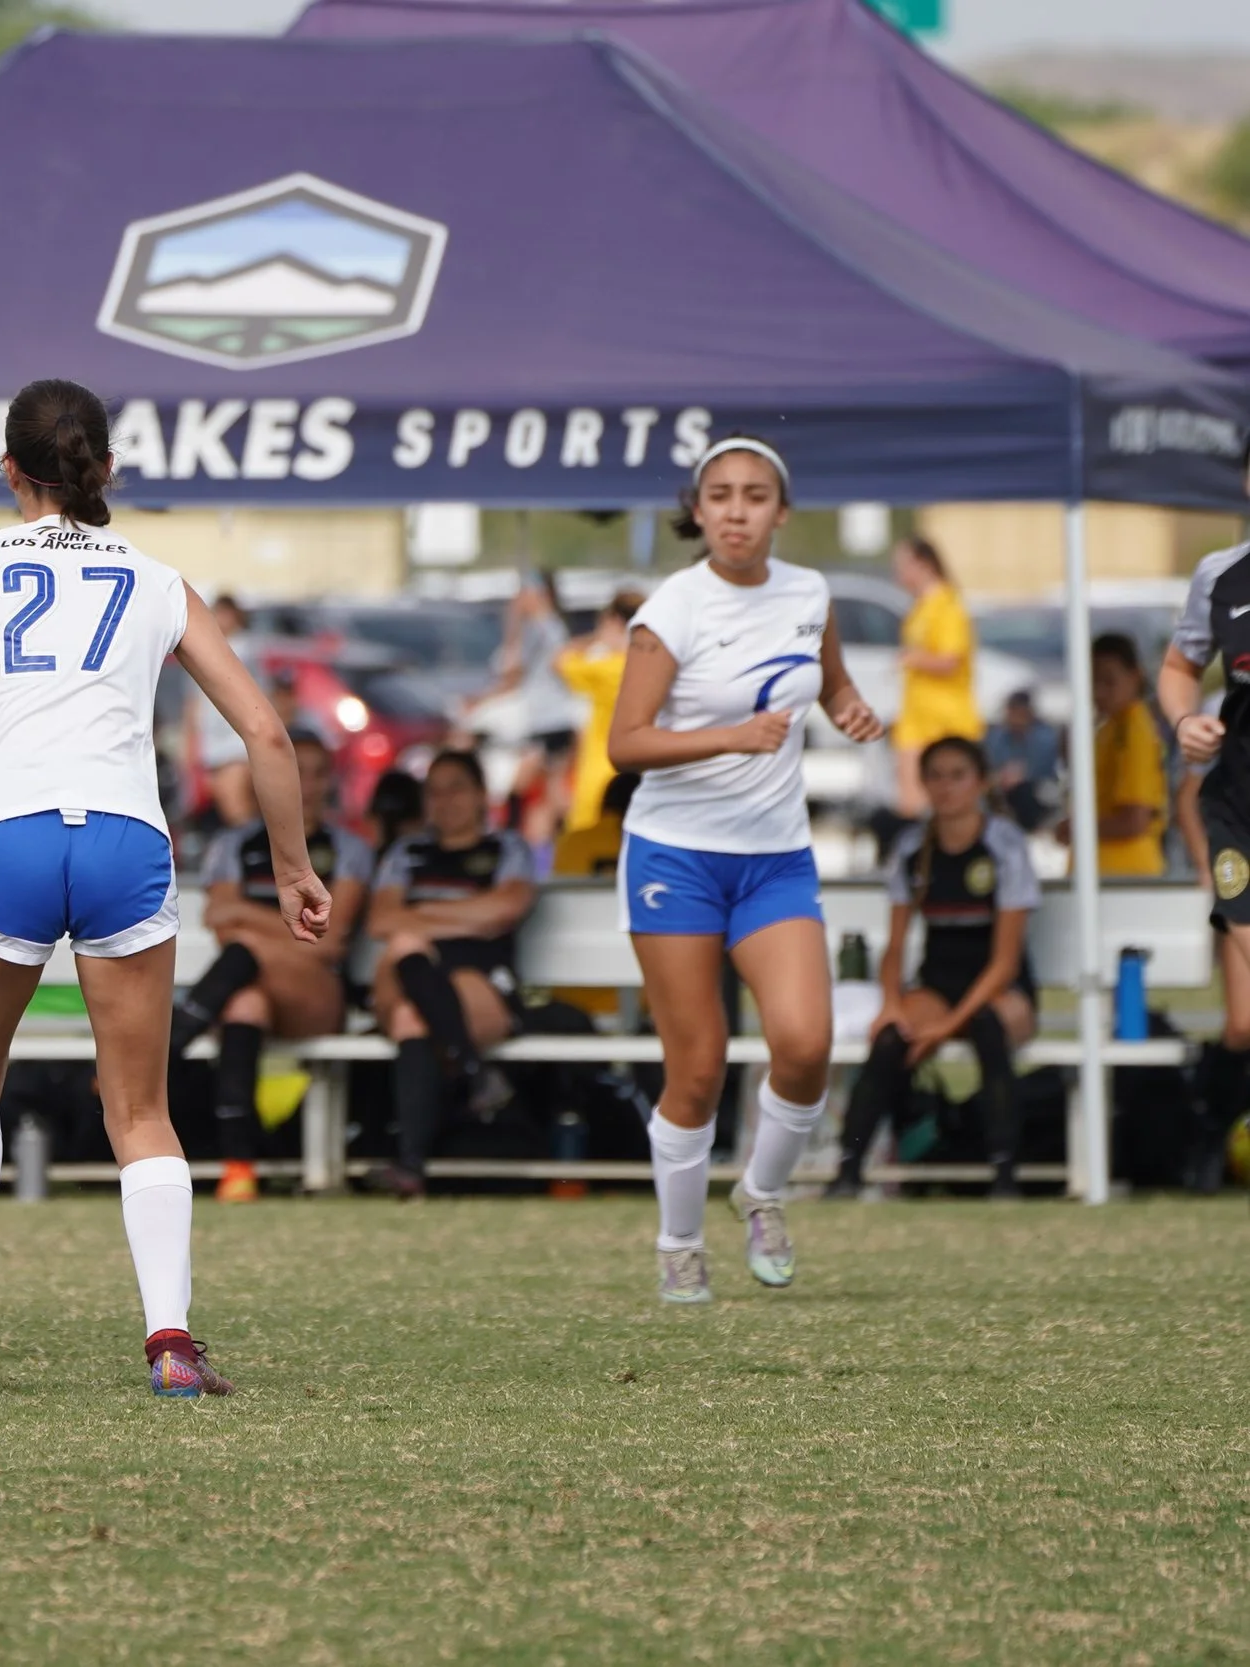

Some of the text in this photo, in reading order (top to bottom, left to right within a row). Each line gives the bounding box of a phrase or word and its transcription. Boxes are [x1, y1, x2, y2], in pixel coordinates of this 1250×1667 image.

[392, 406, 713, 469] SPORTS
[1, 538, 128, 555] LOS ANGELES
[48, 532, 92, 542] SURF
[2, 562, 136, 675] 27
